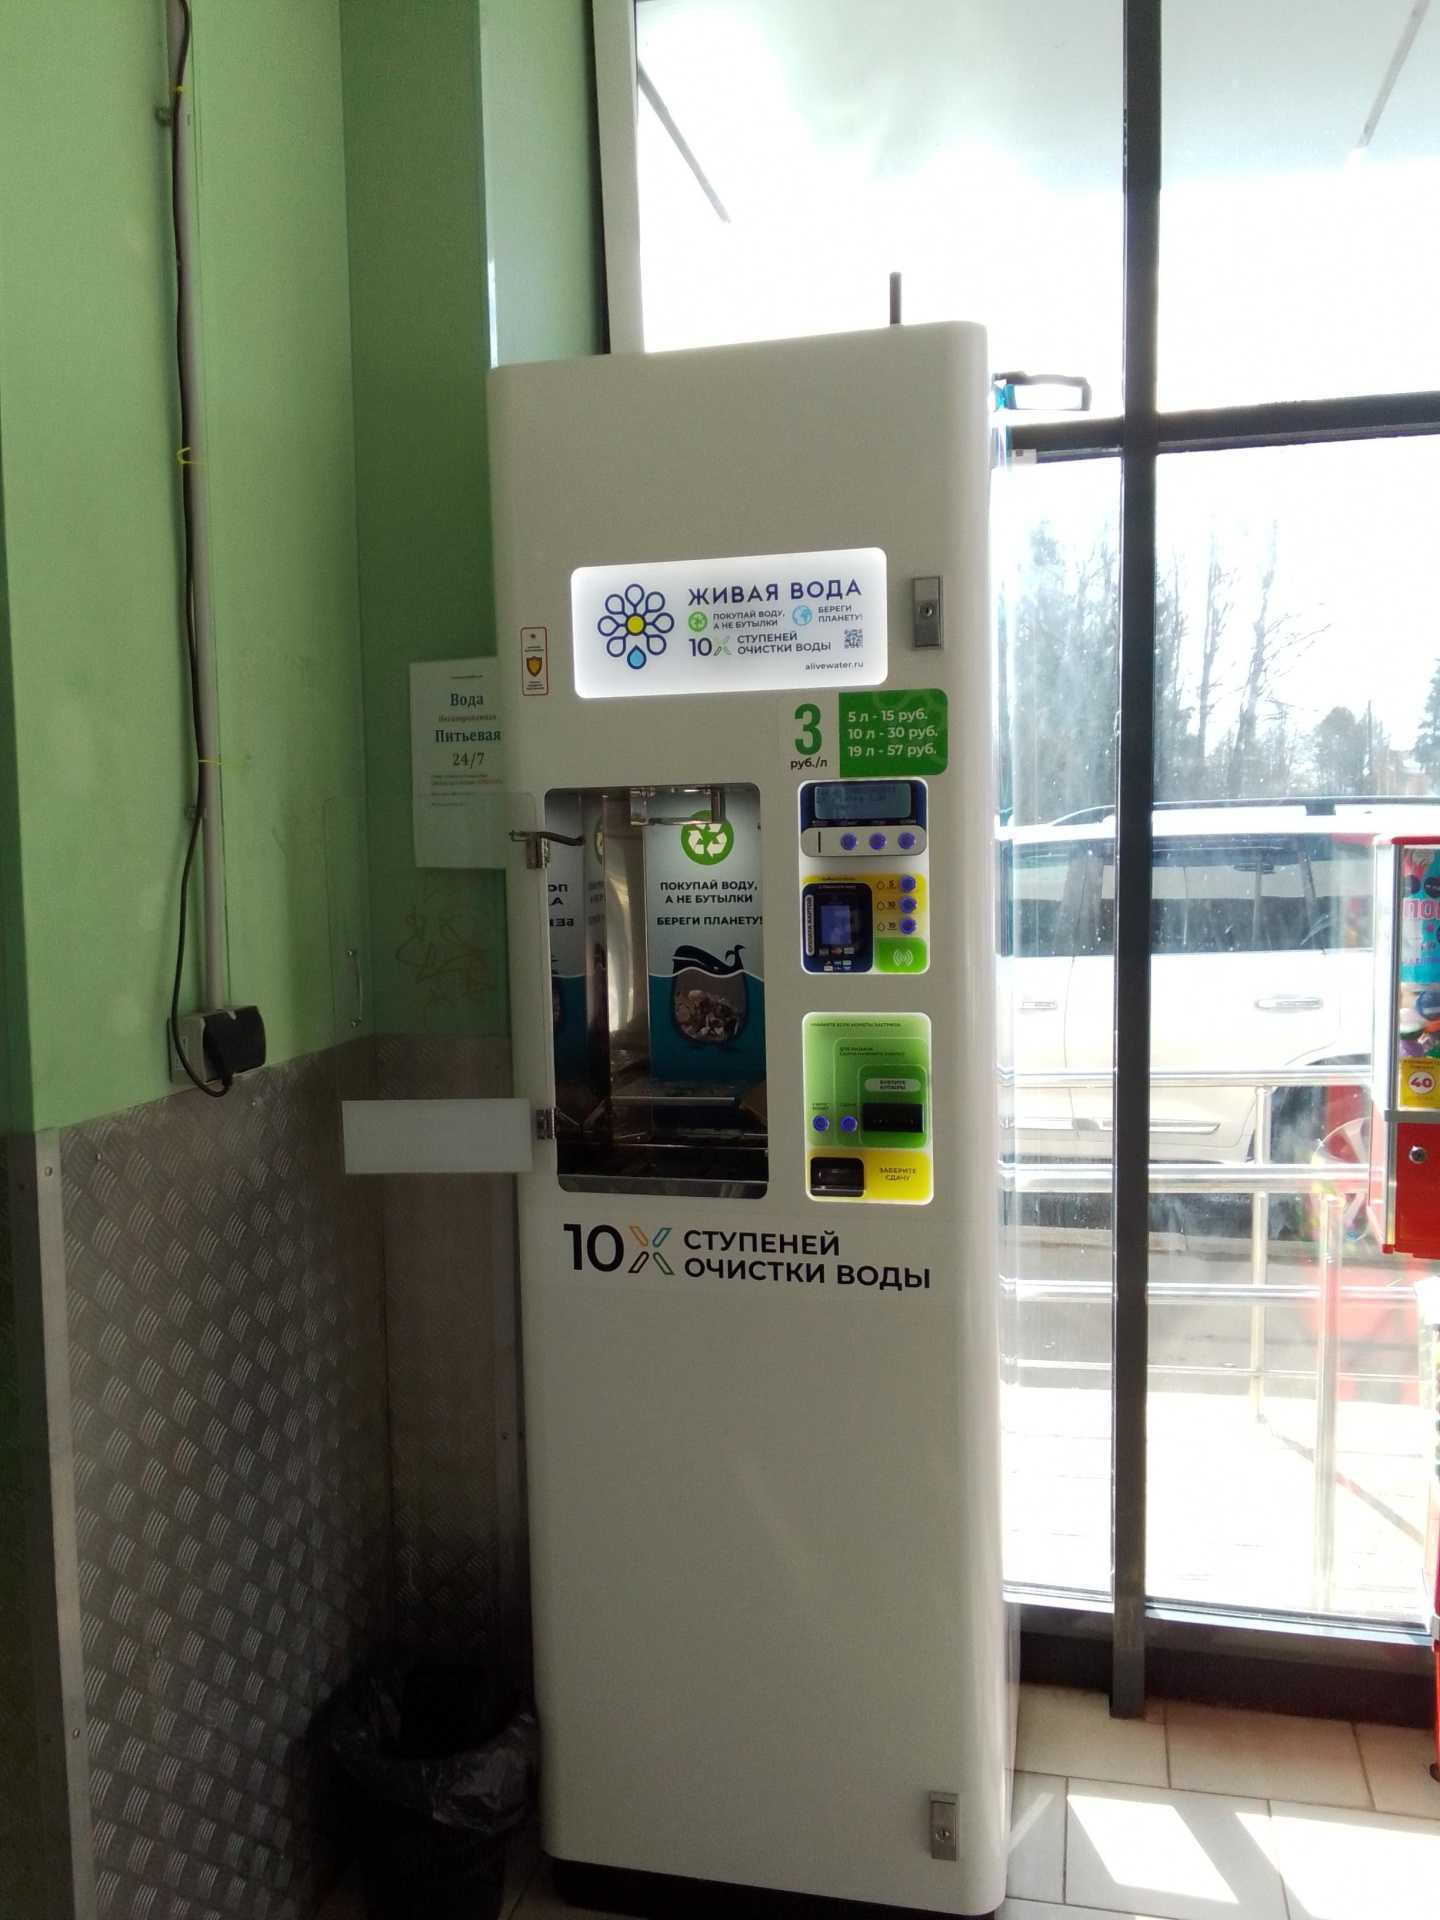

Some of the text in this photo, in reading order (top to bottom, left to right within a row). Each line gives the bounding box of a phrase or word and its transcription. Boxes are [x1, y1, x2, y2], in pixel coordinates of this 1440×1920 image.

[688, 579, 862, 606] ЖИВАЯ ВОДА
[712, 609, 785, 620] ПОКУПАЙ ВОДУ,
[818, 604, 852, 614] БЕРЕГИ
[713, 620, 778, 630] А НЕ БУТЫЛКИ
[737, 631, 798, 644] СТУПЕНЕЙ
[737, 641, 831, 655] ОЧИСТКИ ВОДЫ
[804, 660, 864, 671] alivewater.ru
[450, 693, 484, 707] Вода
[848, 712, 856, 722] 5
[859, 711, 869, 722] л
[881, 710, 894, 721] 15
[899, 708, 928, 723] руб.
[435, 729, 502, 743] Питьевая
[794, 703, 823, 756] 3
[848, 729, 862, 740] 10
[866, 728, 875, 739] л
[887, 727, 905, 738] 30
[909, 725, 938, 739] руб.
[848, 746, 862, 757] 19
[866, 746, 875, 756] л
[887, 744, 903, 755] 57
[907, 742, 937, 757] руб.
[452, 752, 485, 769] 24/7
[790, 757, 828, 770] руб./л
[660, 880, 758, 891] ПОКУПАЙ ВОДУ,
[665, 894, 753, 904] А НЕ БУТЫЛКИ
[657, 915, 763, 926] БЕРЕГИ ПЛАНЕТУ!
[1411, 1077, 1433, 1088] 40
[683, 1229, 840, 1257] СТУПЕНЕЙ
[684, 1257, 931, 1291] ОЧИСТКИ ВОДЫ
